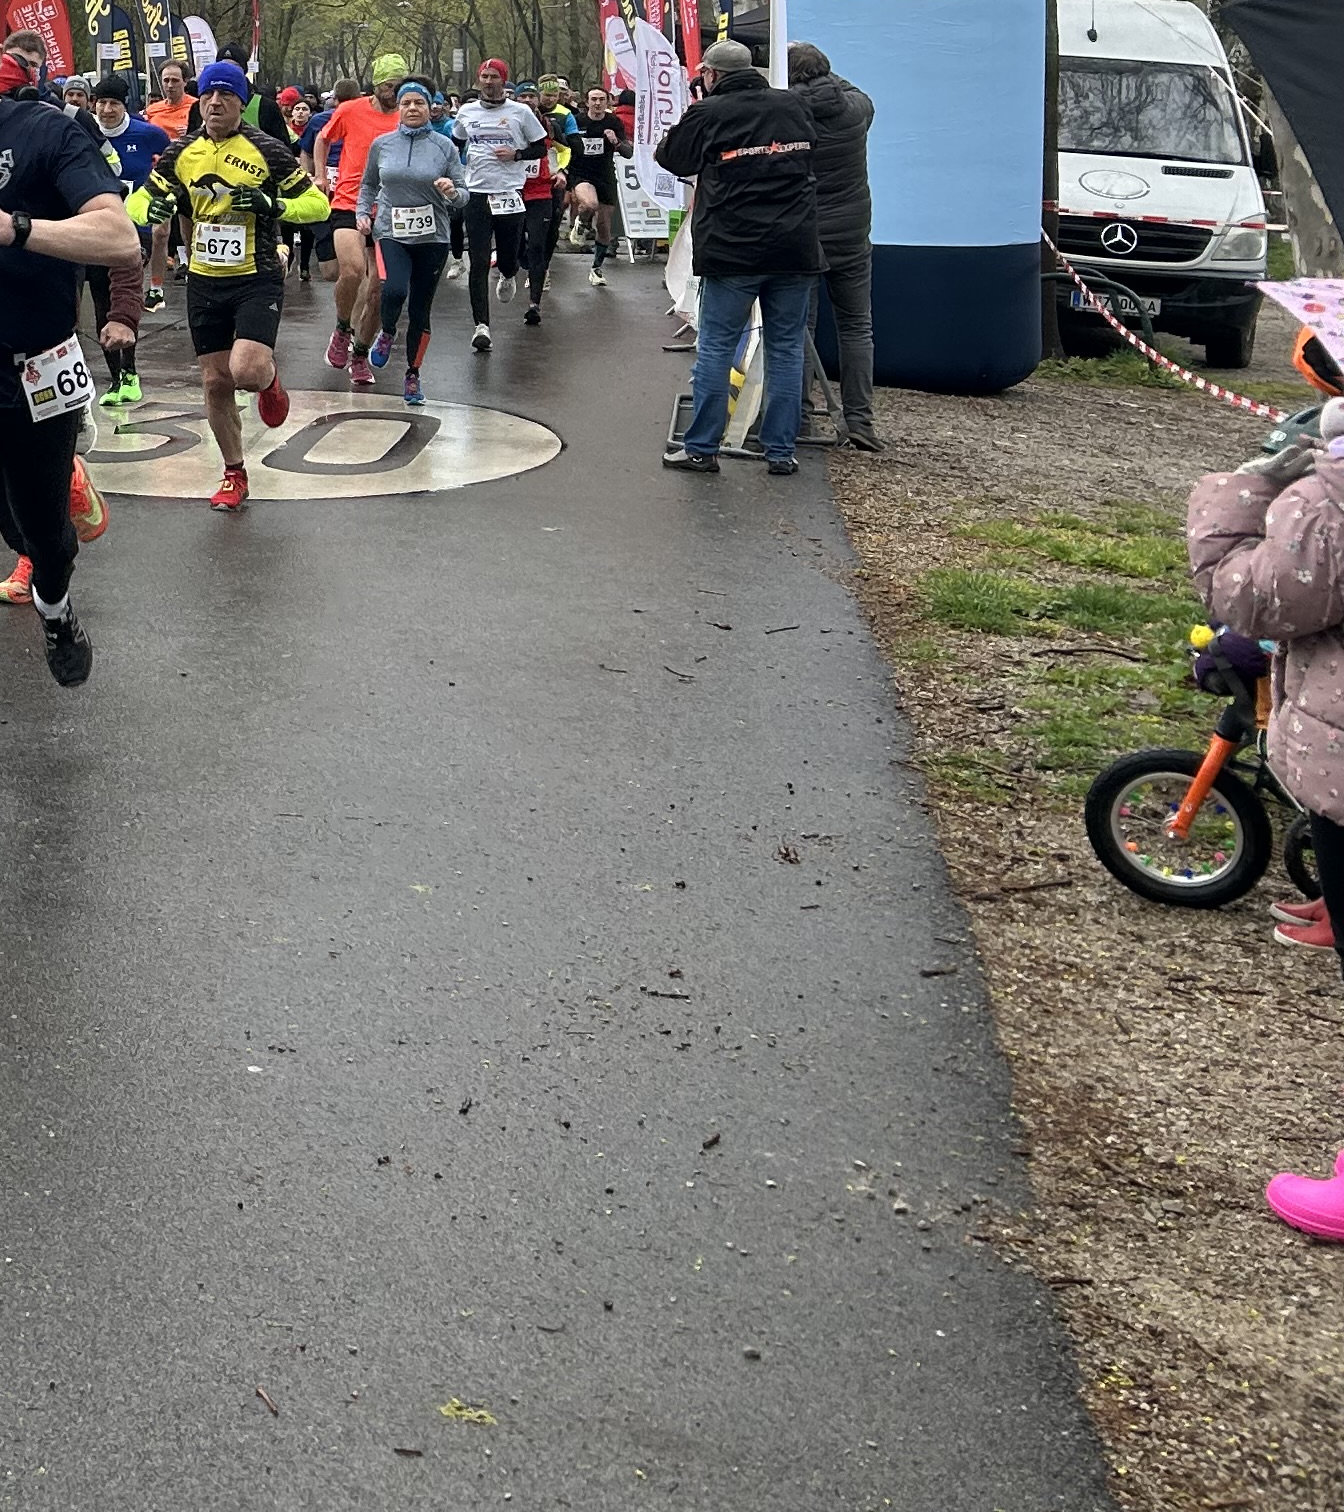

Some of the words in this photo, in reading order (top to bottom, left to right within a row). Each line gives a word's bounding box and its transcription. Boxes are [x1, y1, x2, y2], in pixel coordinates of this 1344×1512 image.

[585, 143, 602, 151] 747
[224, 153, 266, 178] ERNST
[501, 197, 522, 208] 731
[406, 215, 433, 229] 739
[207, 238, 242, 256] 673
